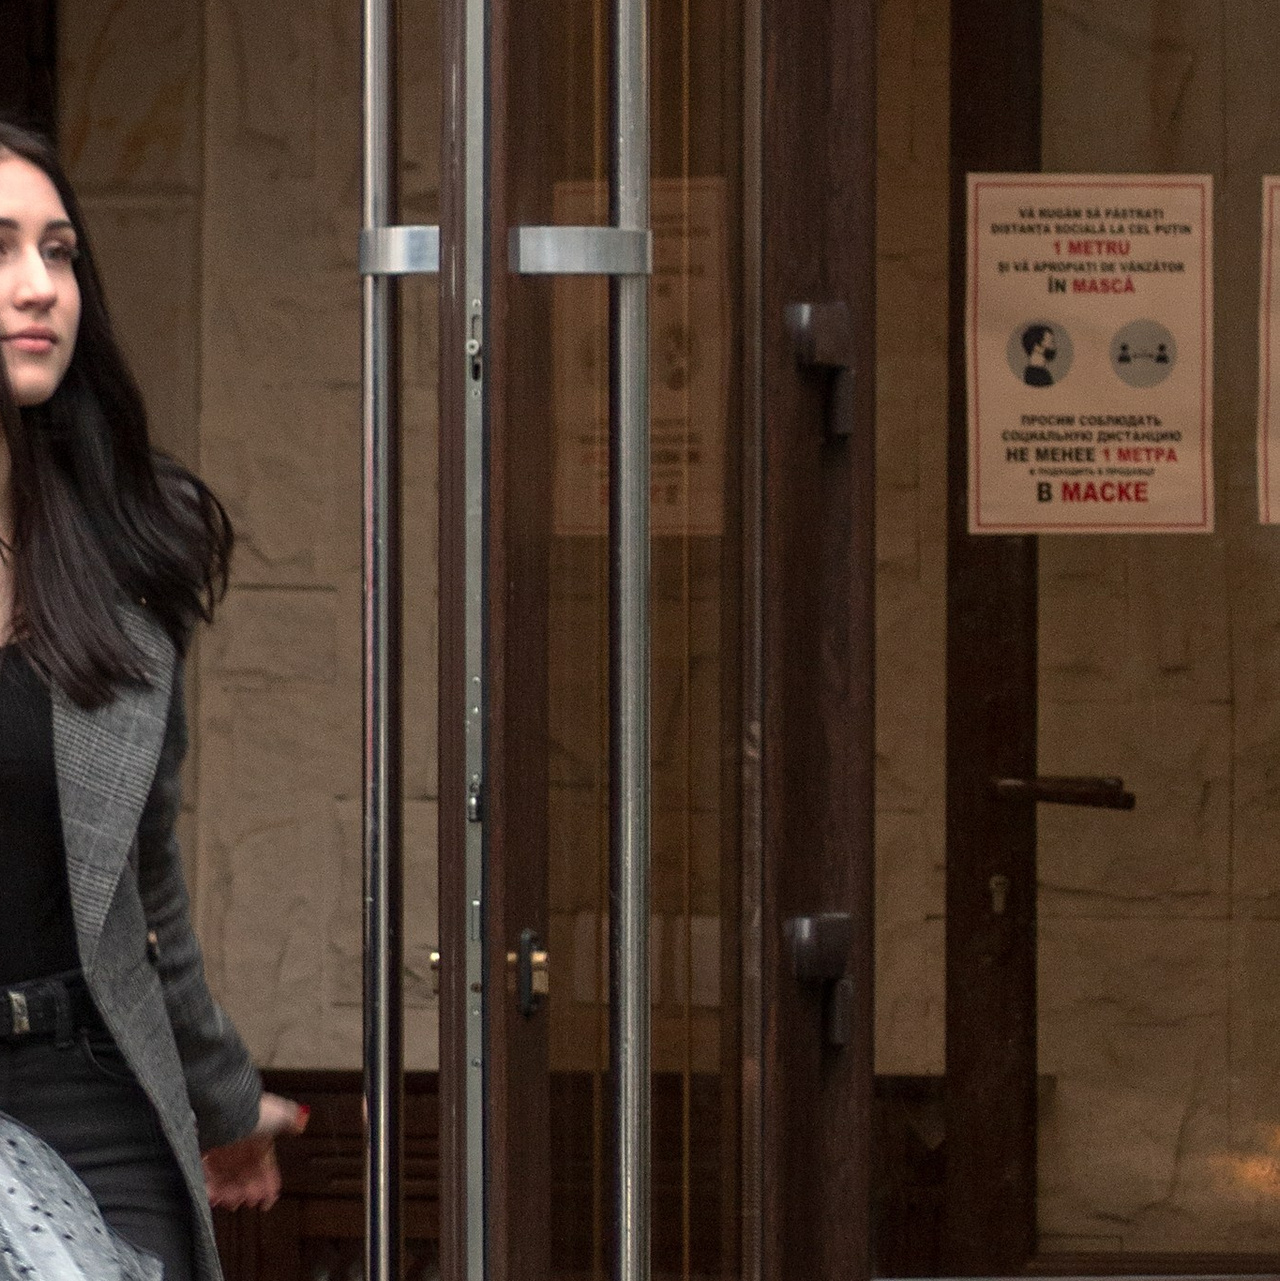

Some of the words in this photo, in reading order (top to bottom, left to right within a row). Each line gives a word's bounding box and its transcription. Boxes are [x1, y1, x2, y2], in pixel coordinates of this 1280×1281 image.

[1054, 241, 1061, 254] 1
[1068, 240, 1131, 255] METRU
[1006, 448, 1028, 462] НЕ
[1036, 448, 1095, 462] МЕНЕЕ
[1102, 448, 1109, 462] 1
[1118, 448, 1177, 462] МЕТРА
[1037, 482, 1052, 502] В
[1062, 482, 1148, 502] МАСКЕ
